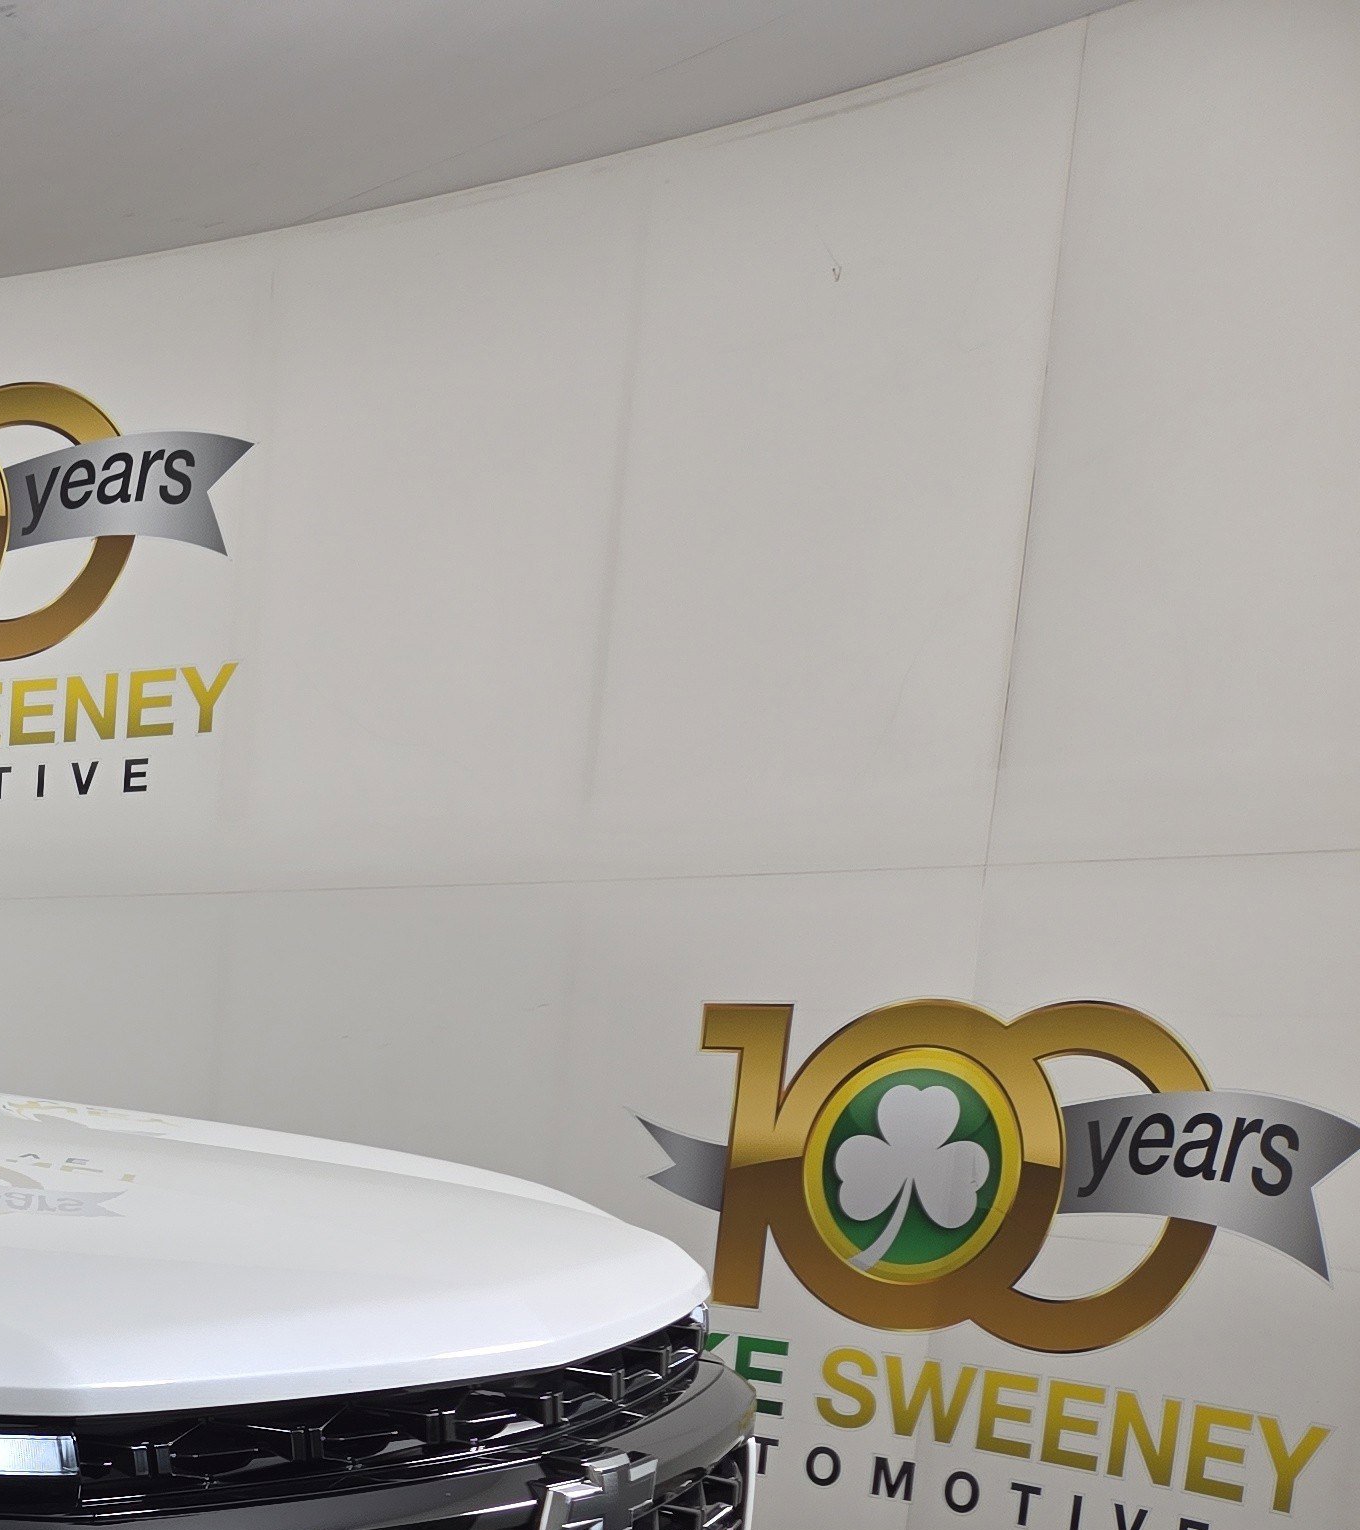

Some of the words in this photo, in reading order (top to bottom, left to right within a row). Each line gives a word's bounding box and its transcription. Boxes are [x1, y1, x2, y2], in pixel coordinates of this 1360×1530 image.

[20, 447, 197, 536] years
[1076, 1110, 1302, 1199] years
[815, 1347, 1332, 1515] SWEENEY
